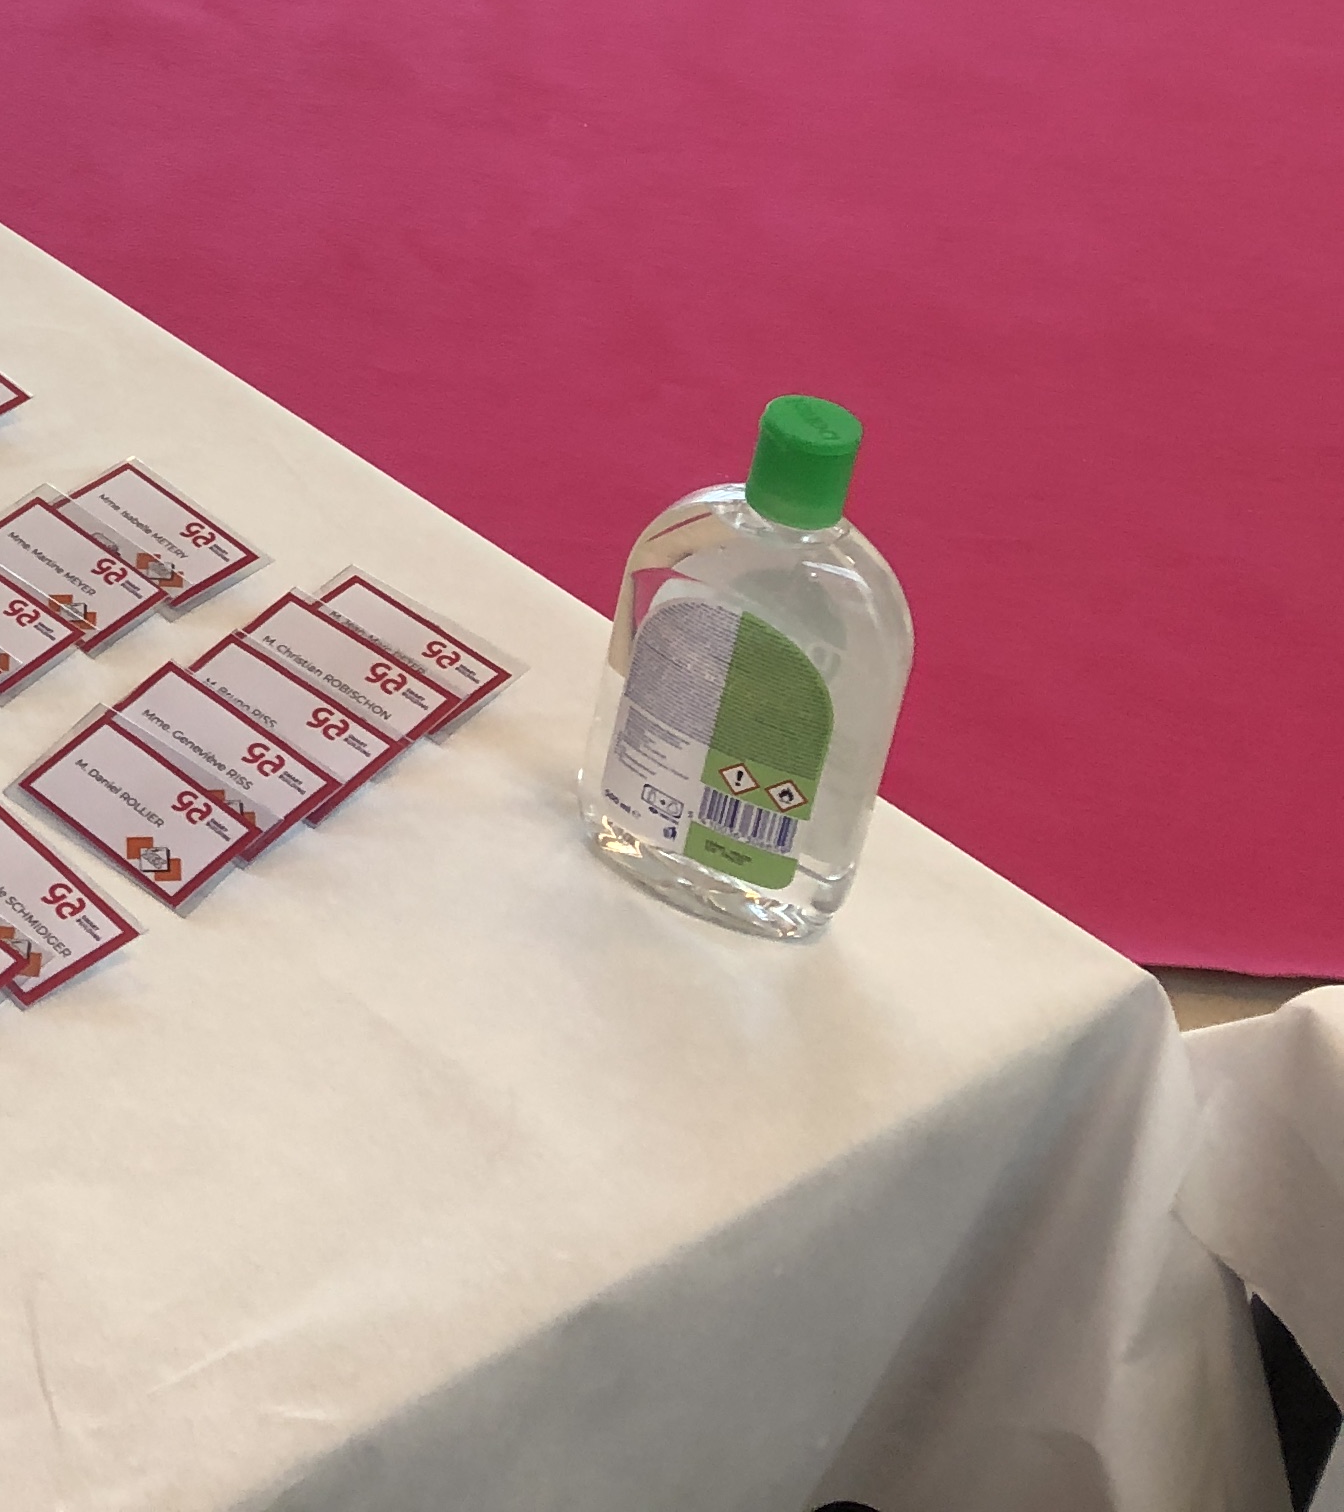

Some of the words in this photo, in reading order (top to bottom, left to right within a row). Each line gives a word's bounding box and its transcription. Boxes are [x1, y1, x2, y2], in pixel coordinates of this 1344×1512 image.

[120, 510, 152, 534] Isabelle
[31, 548, 64, 574] Martine
[62, 571, 96, 596] MEYER
[275, 643, 323, 677] Christian
[322, 673, 392, 720] ROBISCHON
[248, 707, 280, 728] RISS
[141, 708, 170, 732] Mme.
[225, 768, 253, 790] RISS
[87, 767, 122, 794] Daniel
[118, 791, 164, 828] ROLLIER
[4, 895, 72, 958] SCHMIDIGER
